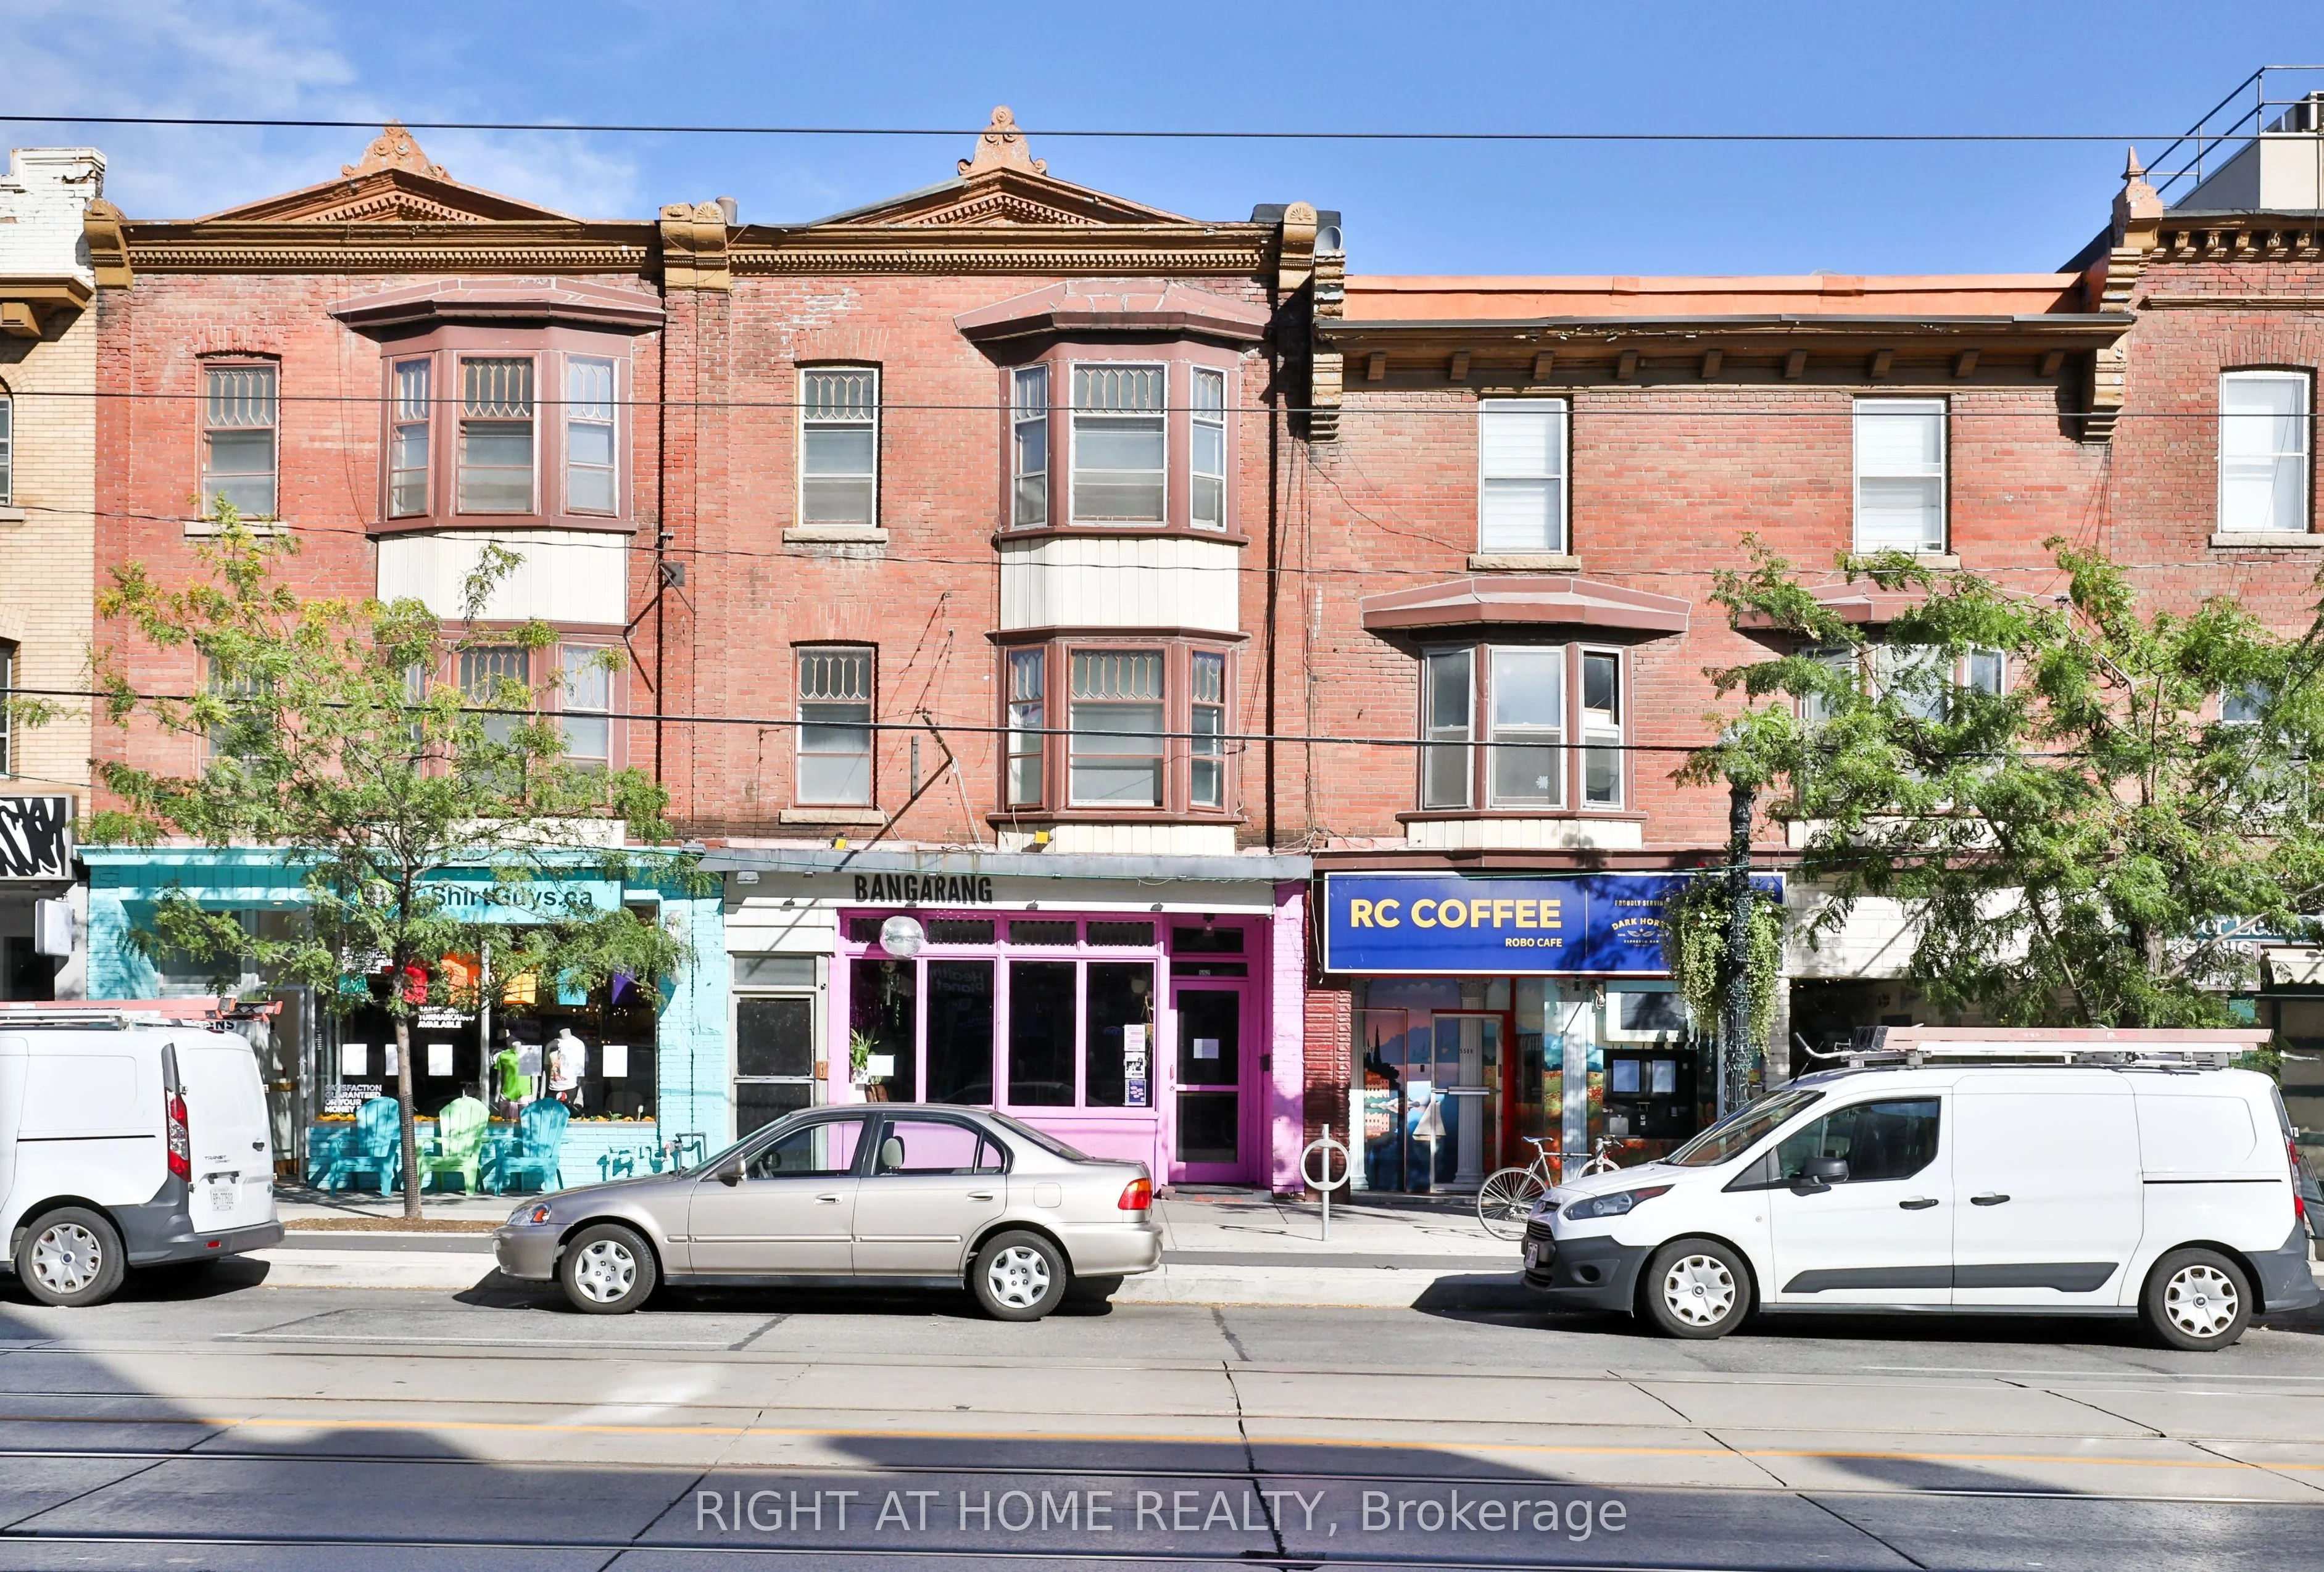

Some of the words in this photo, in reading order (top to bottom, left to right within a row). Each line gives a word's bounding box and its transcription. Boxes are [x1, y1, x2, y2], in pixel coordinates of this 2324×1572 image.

[854, 874, 992, 904] BANGARANG
[1350, 898, 1401, 928] RC
[1411, 898, 1562, 928] COFFEE
[1611, 917, 1637, 930] DARK
[1640, 917, 1666, 929] HOR
[1504, 937, 1535, 948] ROBO
[1536, 937, 1562, 948] CAFE
[417, 1020, 463, 1028] AVAILABLE
[324, 1105, 355, 1113] MONEY
